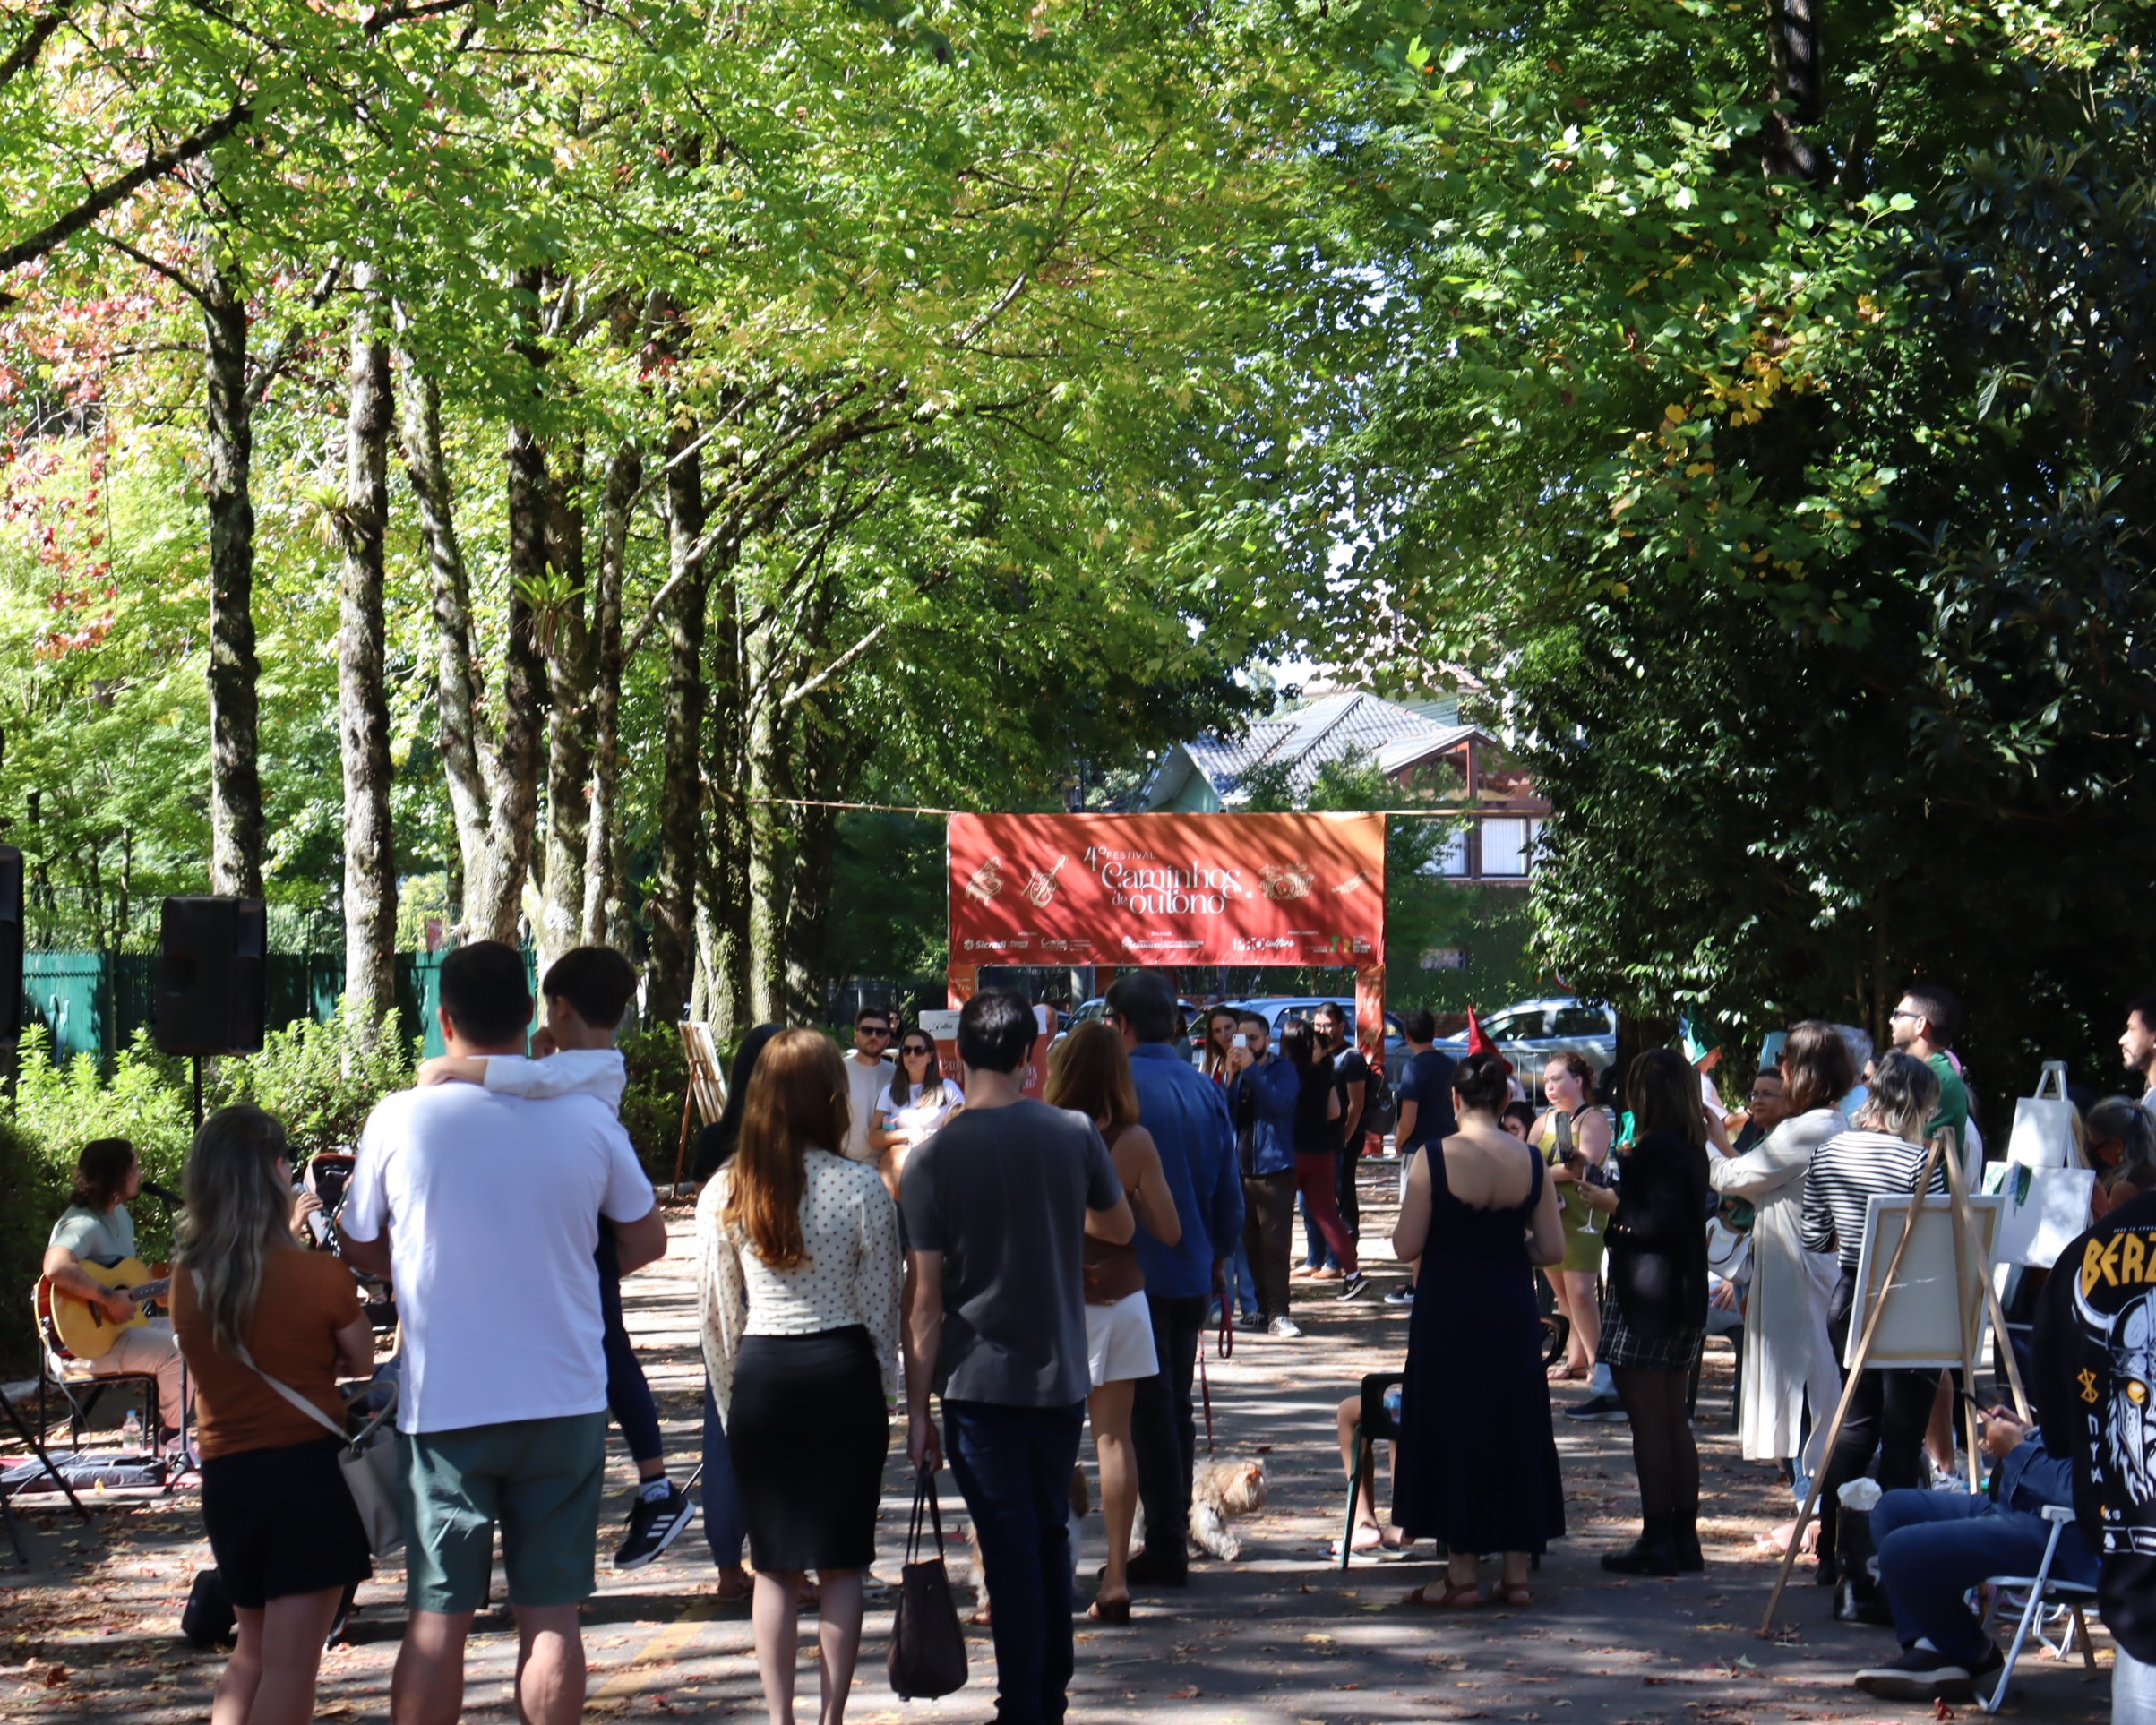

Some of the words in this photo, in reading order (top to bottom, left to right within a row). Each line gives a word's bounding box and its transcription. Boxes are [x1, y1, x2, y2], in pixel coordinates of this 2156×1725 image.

[1106, 851, 1155, 861] FESTIVAL
[1101, 860, 1243, 899] Caminhos
[1112, 889, 1129, 906] de
[1129, 887, 1225, 914] outono
[975, 940, 1007, 950] Sicredi
